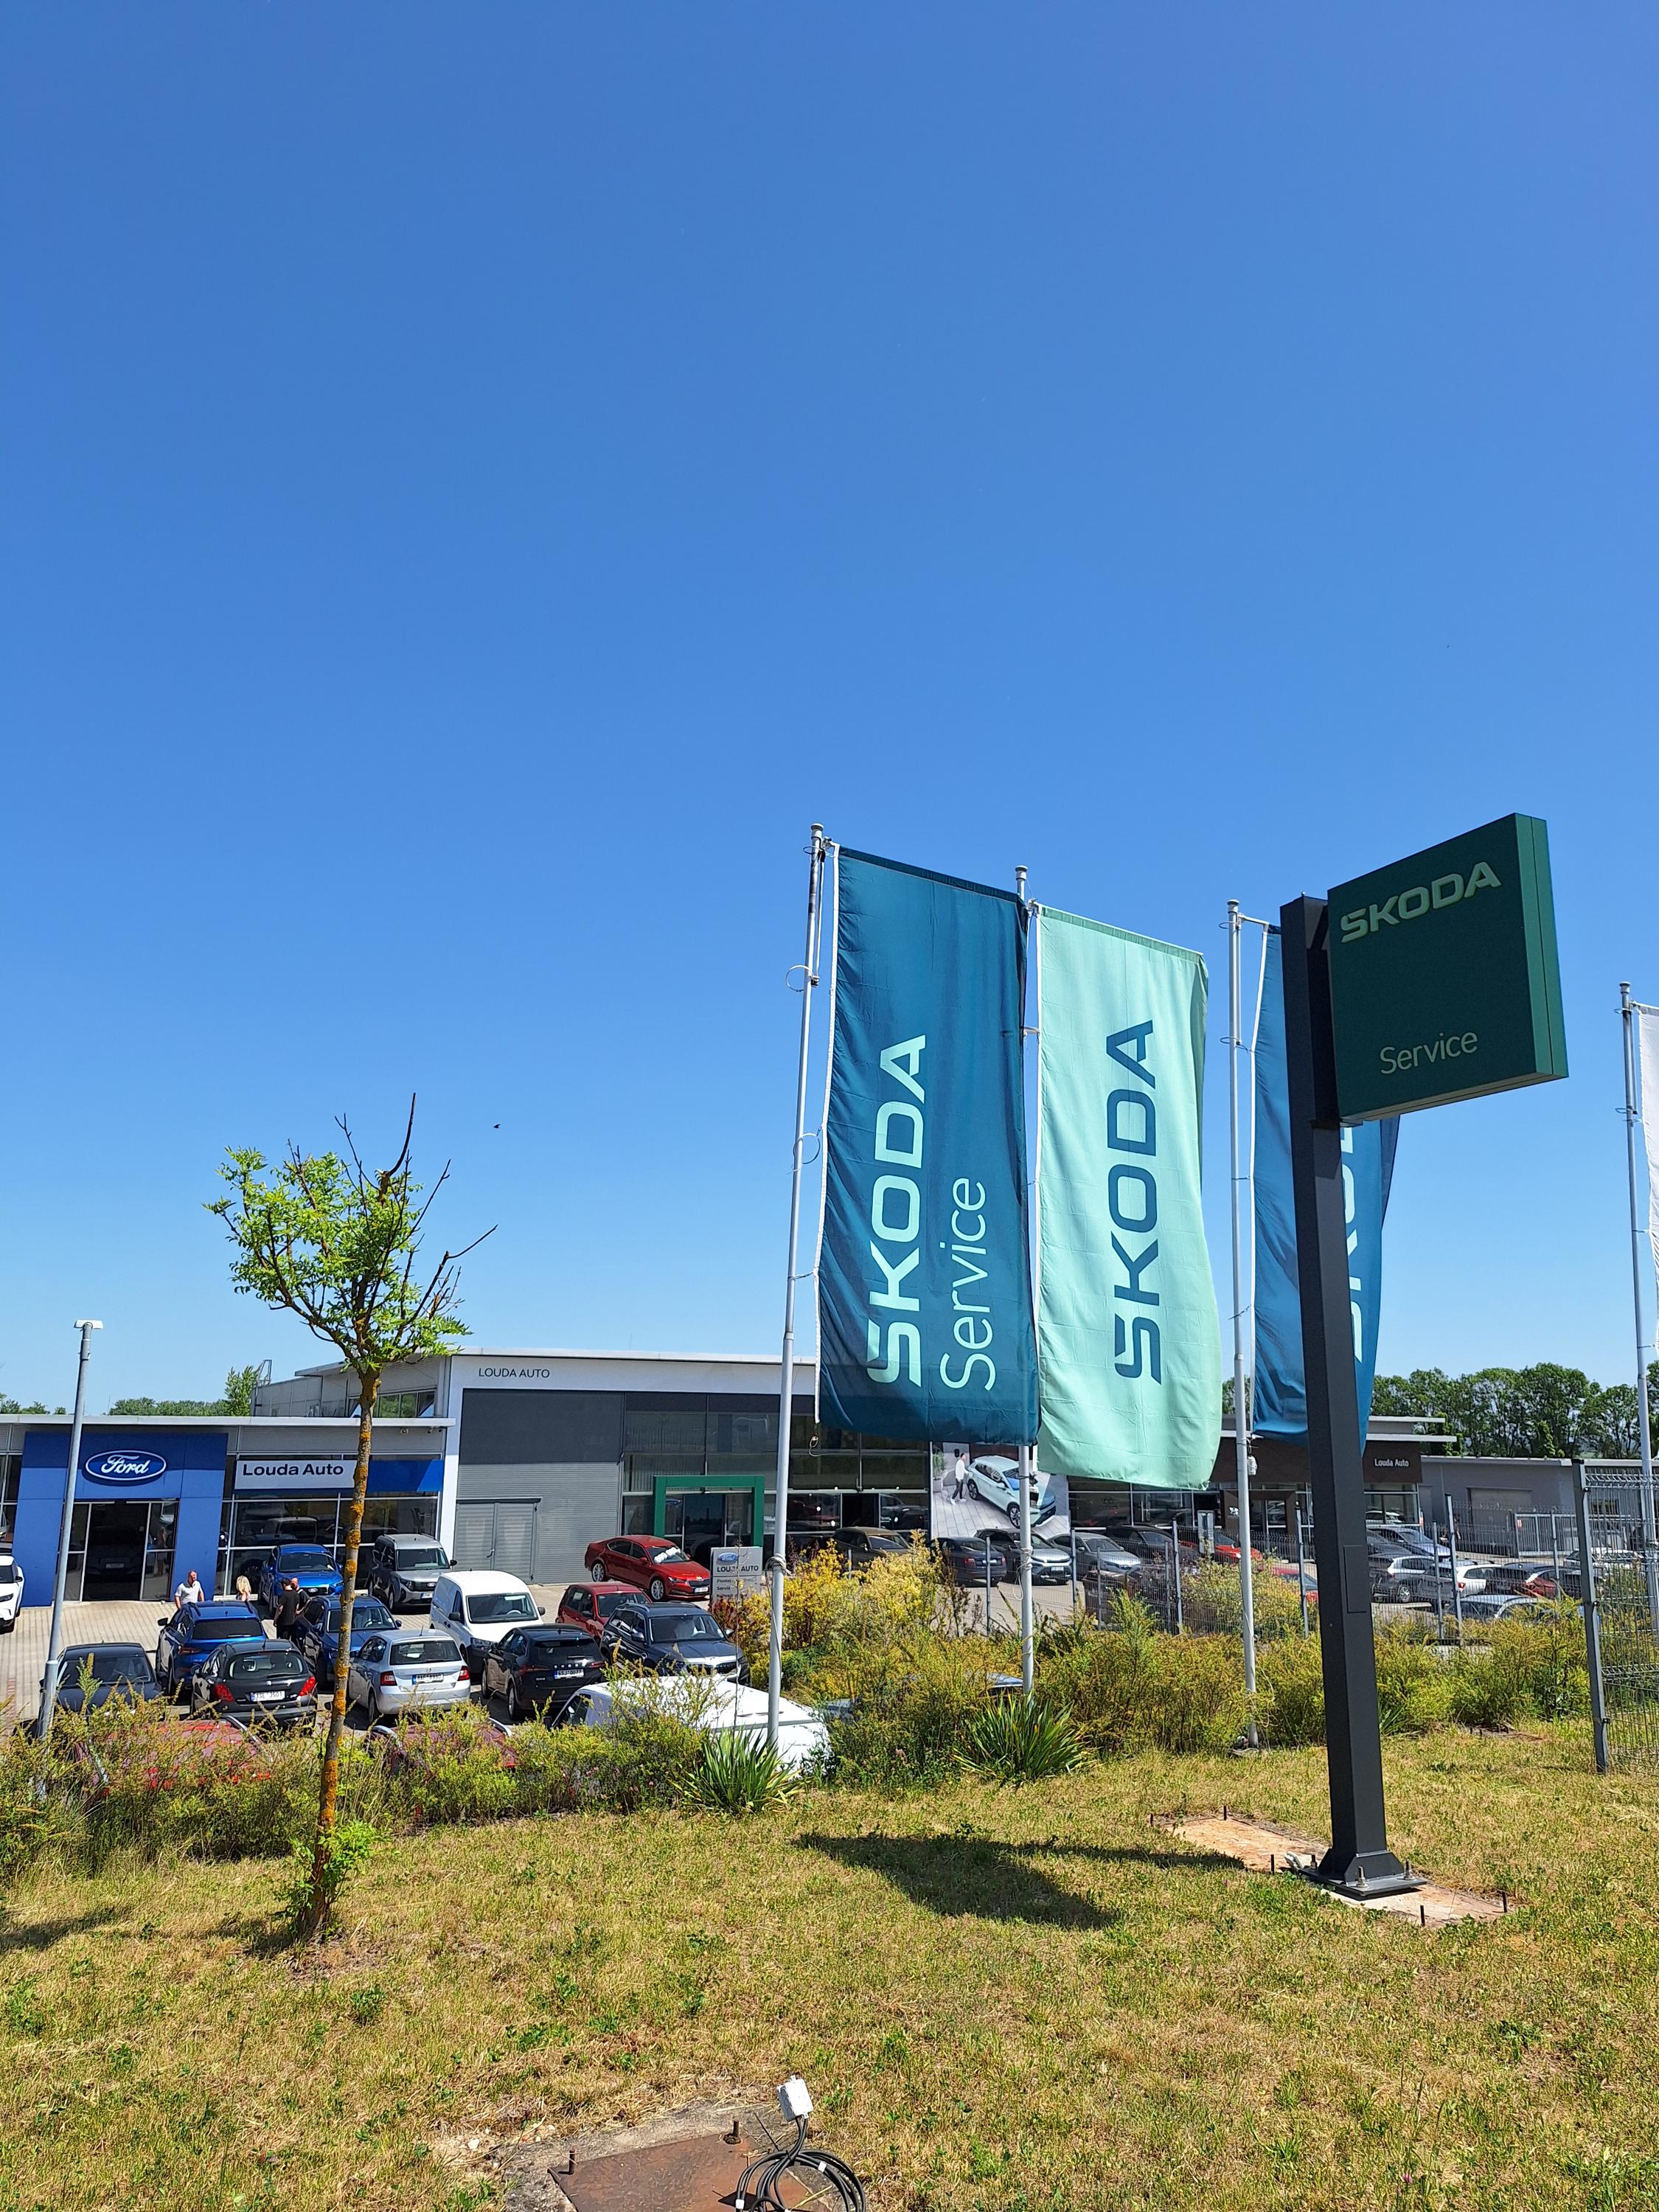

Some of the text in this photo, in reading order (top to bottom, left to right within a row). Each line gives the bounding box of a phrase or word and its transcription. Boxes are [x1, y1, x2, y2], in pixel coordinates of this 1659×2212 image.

[1380, 1032, 1478, 1075] Service
[940, 1178, 996, 1391] Service
[479, 1368, 550, 1378] LOUDA AUTO
[101, 1455, 151, 1475] Ford
[243, 1464, 344, 1475] Louda Auto
[1374, 1458, 1409, 1467] Louda Auto
